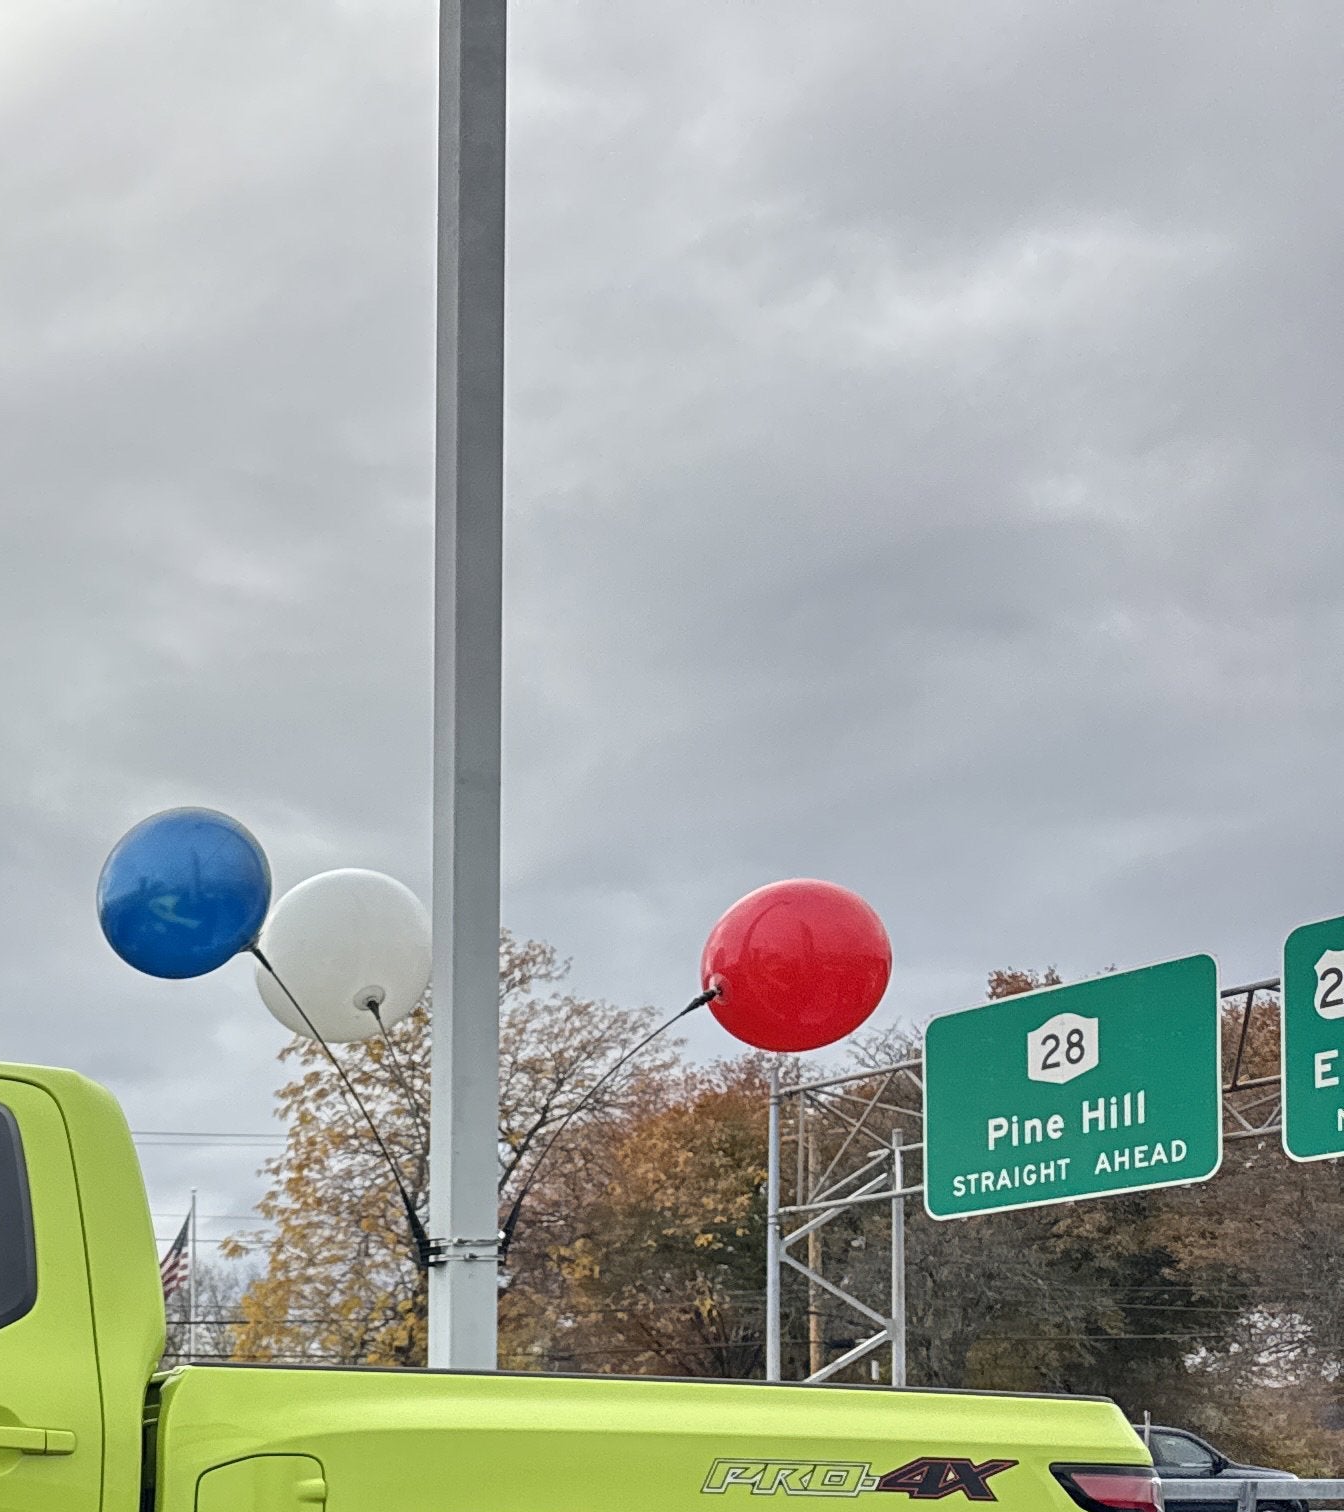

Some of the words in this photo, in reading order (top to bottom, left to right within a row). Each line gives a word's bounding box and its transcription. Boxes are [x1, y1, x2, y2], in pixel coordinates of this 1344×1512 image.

[1040, 1028, 1085, 1071] 28
[987, 1115, 1065, 1151] Pine
[1081, 1090, 1146, 1134] Hill
[952, 1158, 1071, 1197] STRAIGHT
[1094, 1139, 1187, 1176] AHEAD
